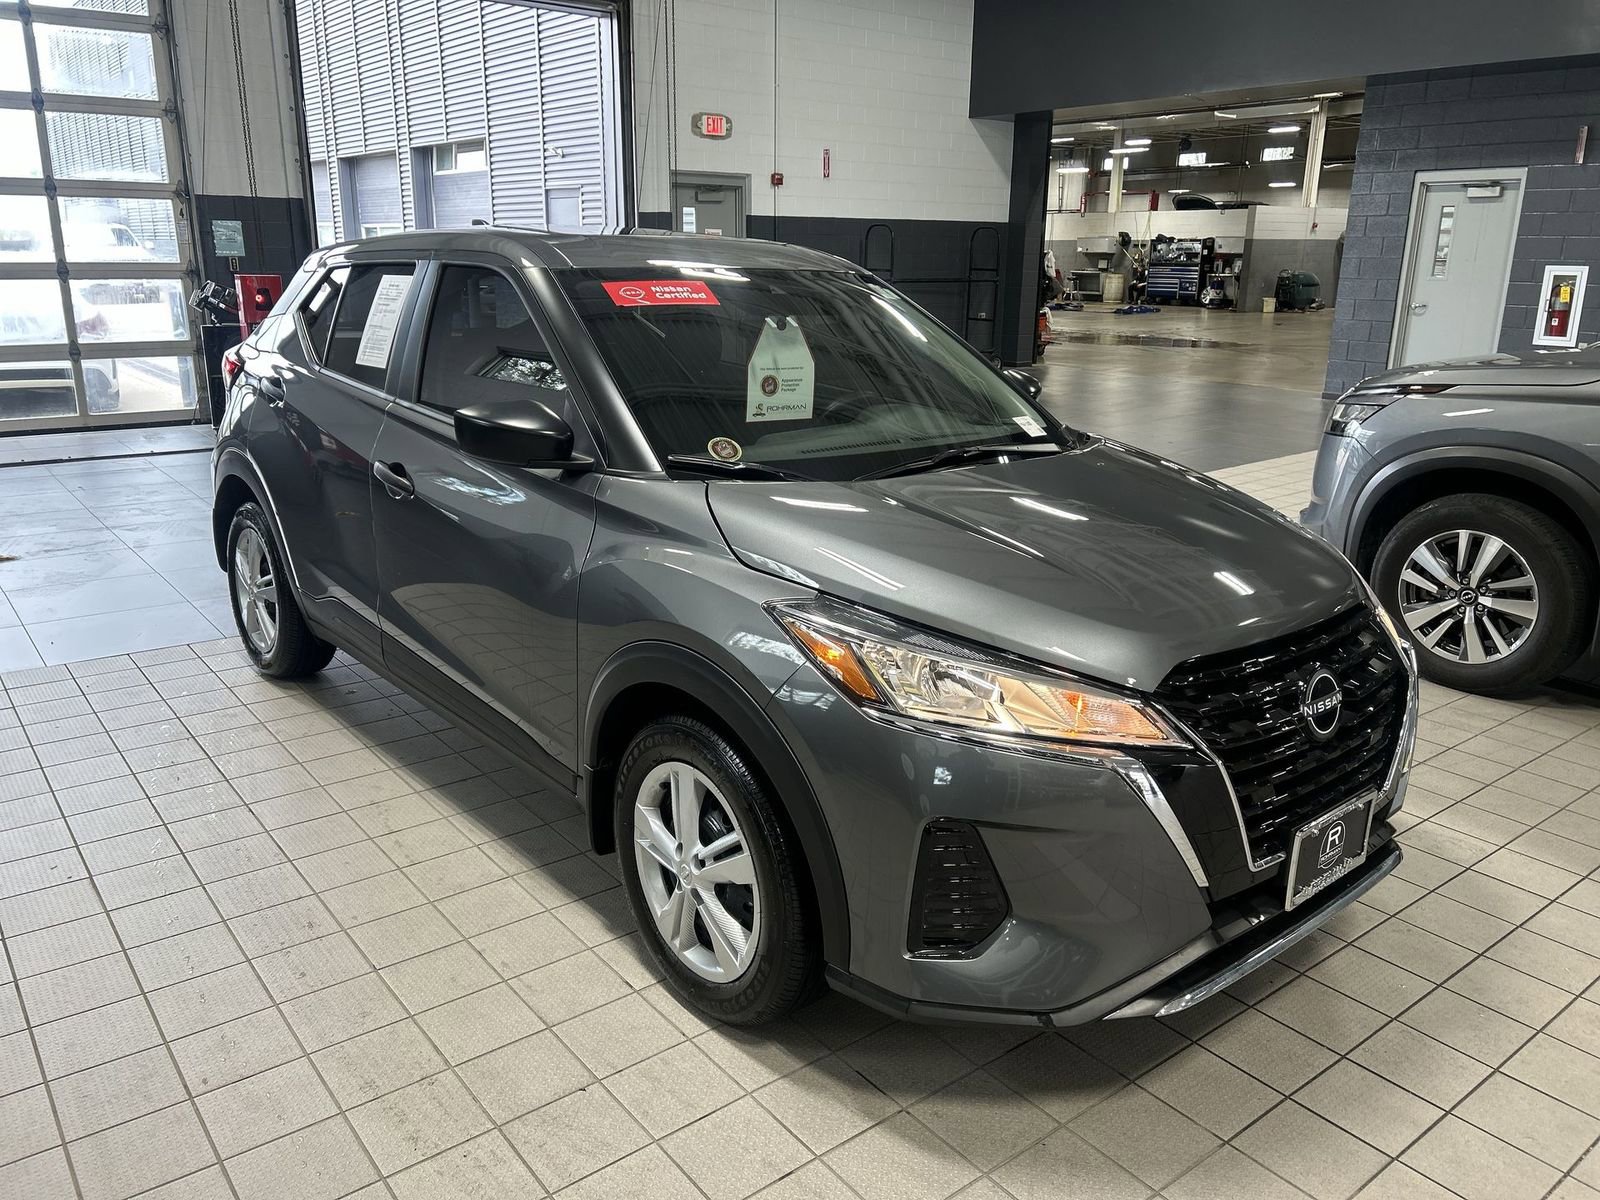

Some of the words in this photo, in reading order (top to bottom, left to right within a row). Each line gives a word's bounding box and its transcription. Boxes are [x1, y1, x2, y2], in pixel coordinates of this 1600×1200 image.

[706, 116, 724, 134] EXIT
[179, 207, 185, 218] 4
[650, 285, 692, 293] Nissan
[655, 291, 707, 299] Certified
[766, 402, 807, 413] ROHRMAN
[1303, 691, 1342, 717] NISSAN
[1327, 825, 1341, 853] R
